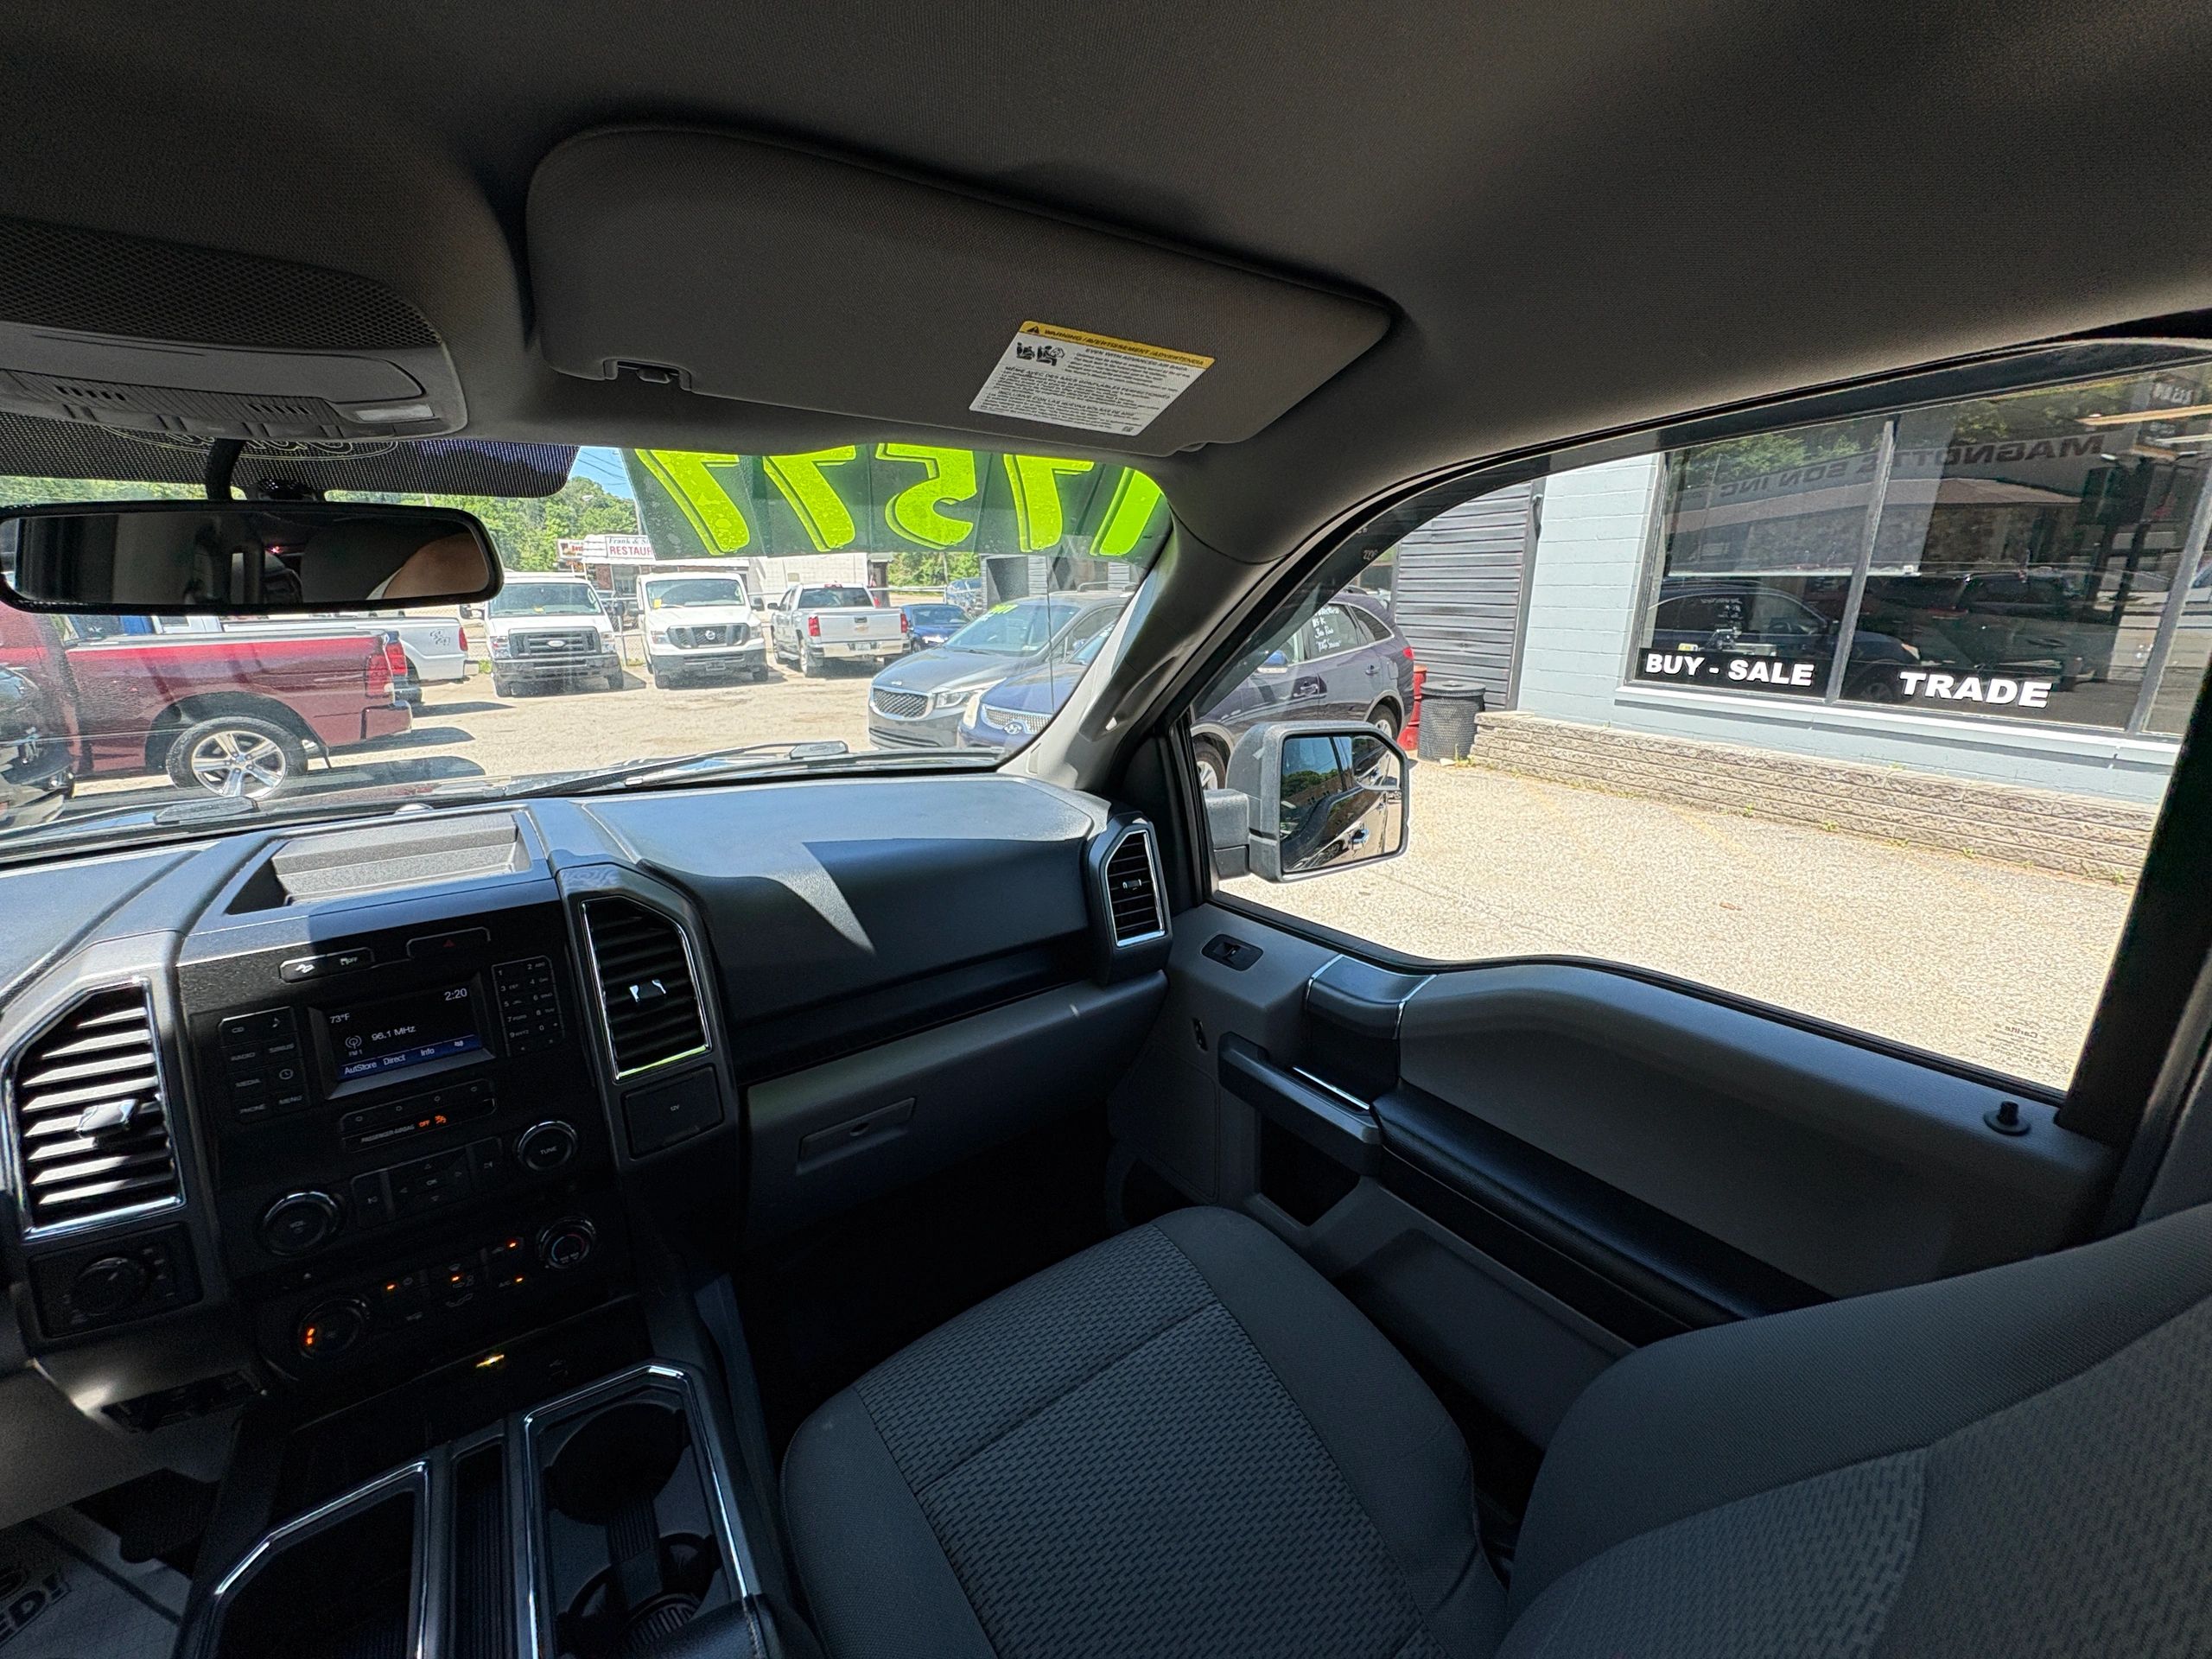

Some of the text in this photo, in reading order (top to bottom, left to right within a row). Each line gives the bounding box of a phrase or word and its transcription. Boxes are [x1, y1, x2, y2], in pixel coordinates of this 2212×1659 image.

[1645, 653, 1705, 677] BUY
[1728, 659, 1815, 687] SALE
[1899, 671, 2053, 709] TRADE
[443, 988, 468, 1001] 2:20
[393, 1026, 416, 1036] MHz
[383, 1053, 406, 1066] Direct
[420, 1046, 435, 1057] Info
[539, 1145, 557, 1155] TUNE
